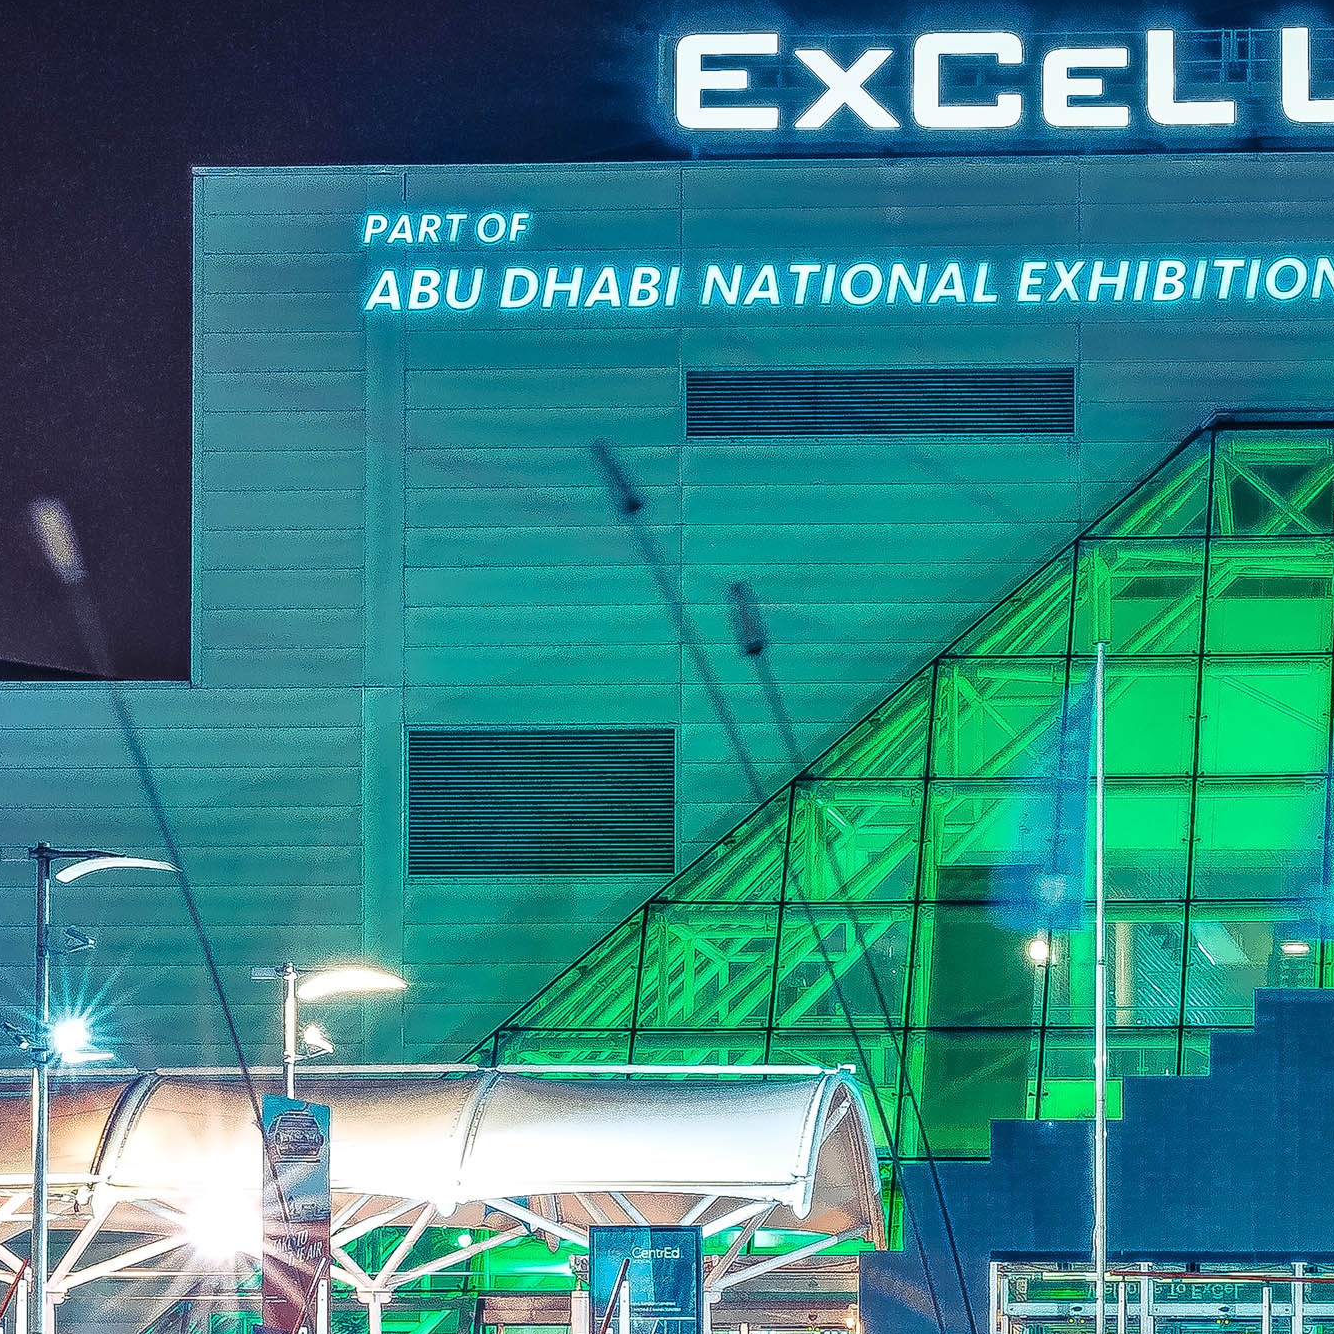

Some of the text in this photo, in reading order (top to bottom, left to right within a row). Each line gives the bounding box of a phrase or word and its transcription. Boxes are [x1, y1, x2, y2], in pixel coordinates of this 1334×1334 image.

[363, 212, 531, 244] PART OF
[365, 266, 484, 311] ABU
[499, 265, 681, 310] DHABI
[700, 262, 998, 307] NATIONAL
[306, 1241, 323, 1260] AIR
[632, 1247, 680, 1258] CentrEd
